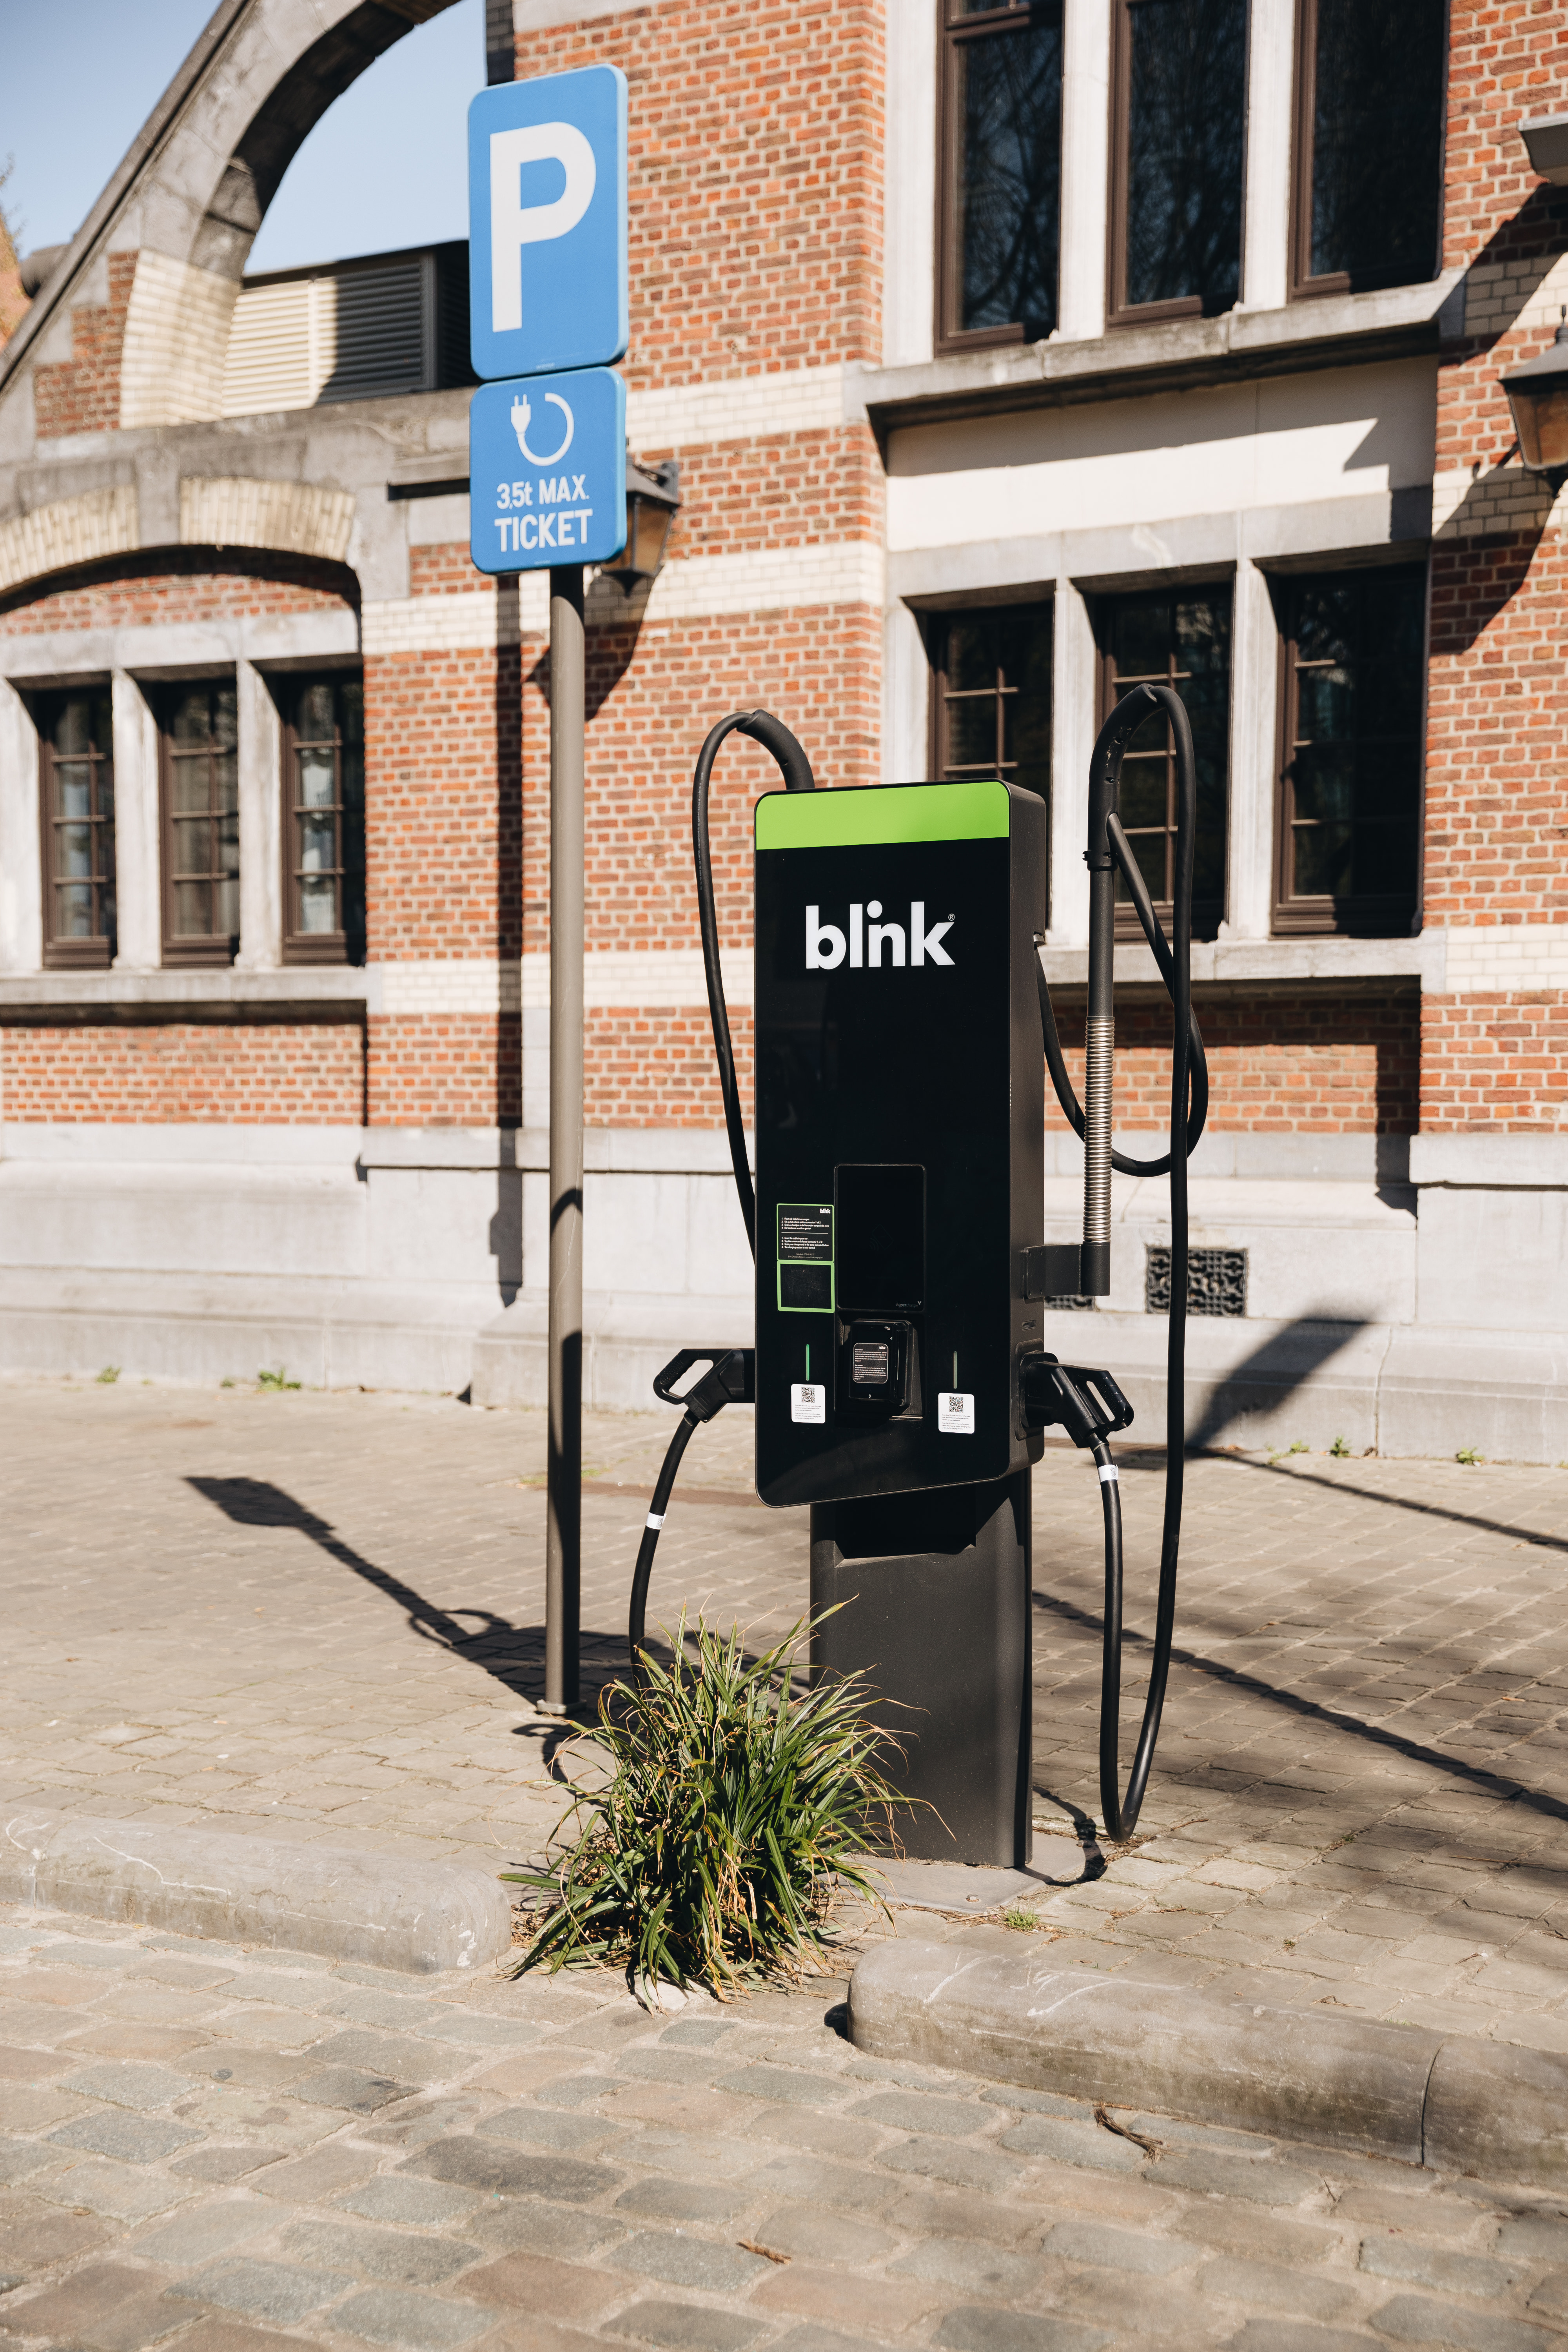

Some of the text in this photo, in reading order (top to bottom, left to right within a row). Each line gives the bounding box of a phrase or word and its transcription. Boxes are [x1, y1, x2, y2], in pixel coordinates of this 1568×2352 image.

[490, 122, 596, 332] P
[497, 475, 589, 509] 3,5t MAX.
[495, 509, 592, 552] TICKET
